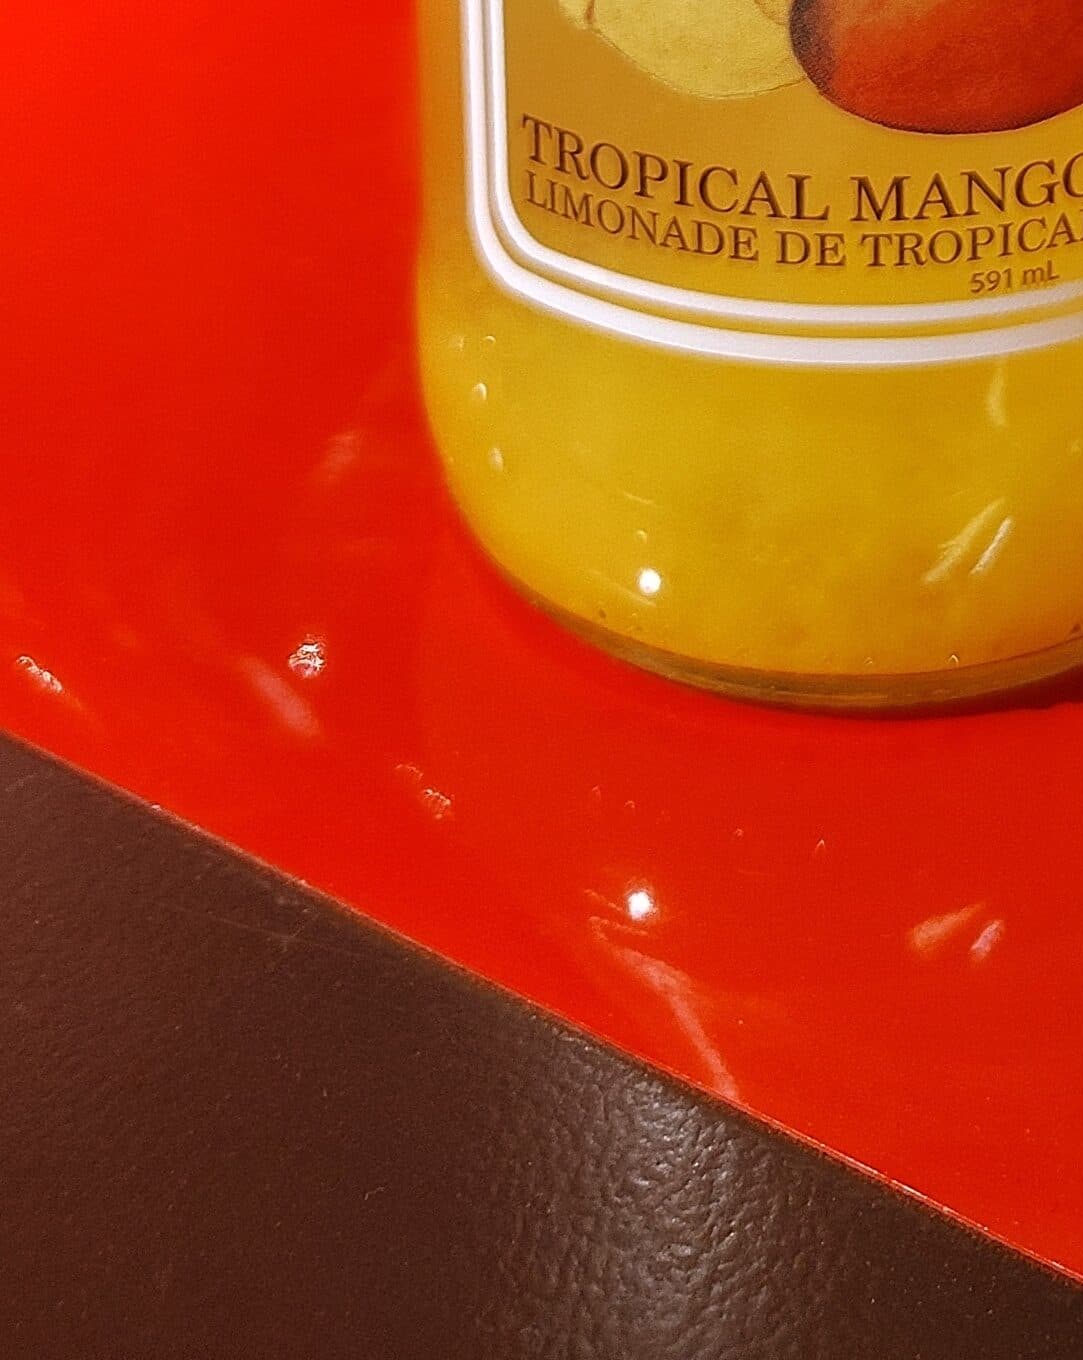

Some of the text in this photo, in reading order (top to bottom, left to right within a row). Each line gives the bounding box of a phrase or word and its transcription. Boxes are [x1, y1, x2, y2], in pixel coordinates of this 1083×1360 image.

[521, 113, 831, 223] TROPICAL
[525, 170, 760, 263] LIMONADE
[775, 230, 847, 267] DE
[970, 259, 1061, 295] 591 mL
